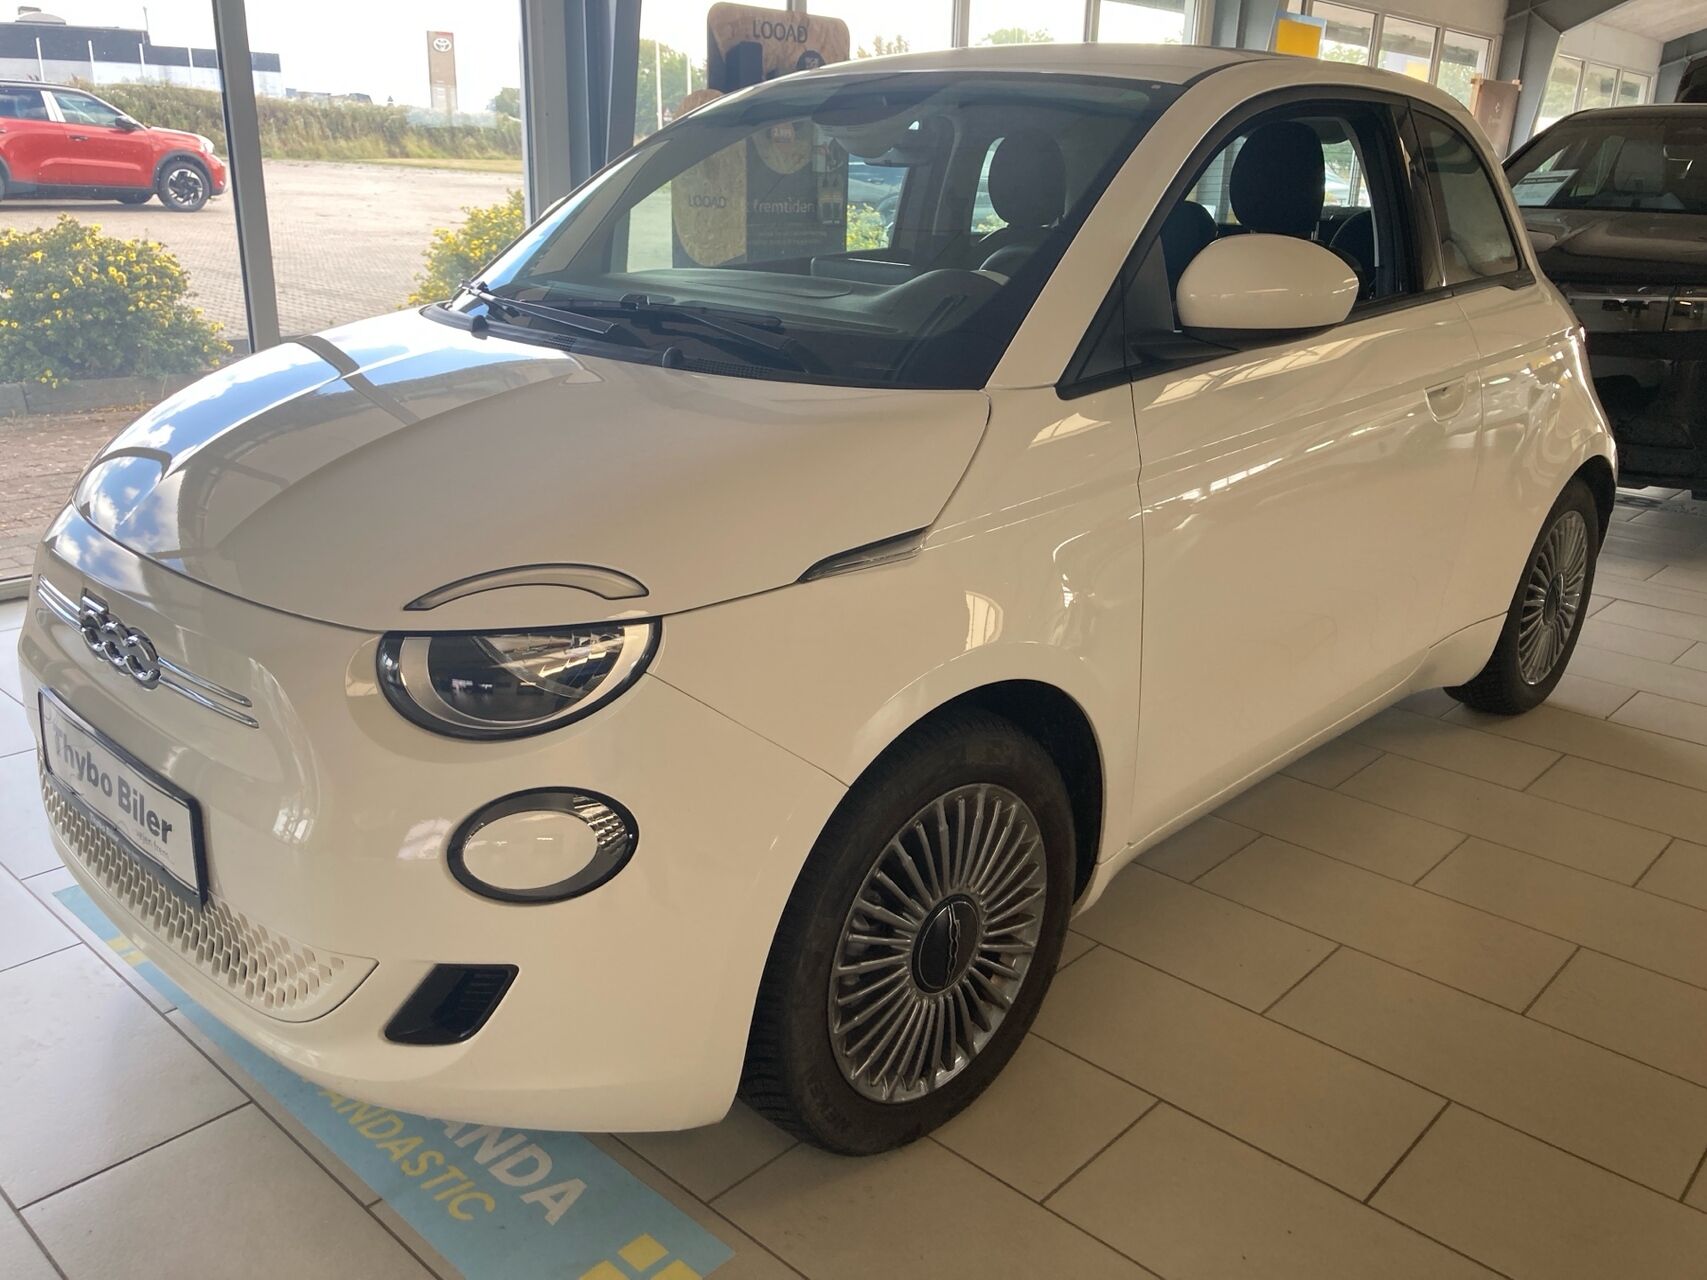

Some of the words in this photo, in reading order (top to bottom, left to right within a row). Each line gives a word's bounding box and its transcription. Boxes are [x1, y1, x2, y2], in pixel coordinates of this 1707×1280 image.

[752, 19, 808, 44] LOOAD
[81, 593, 161, 682] 500
[53, 723, 113, 798] Thybo
[117, 775, 173, 845] Biler
